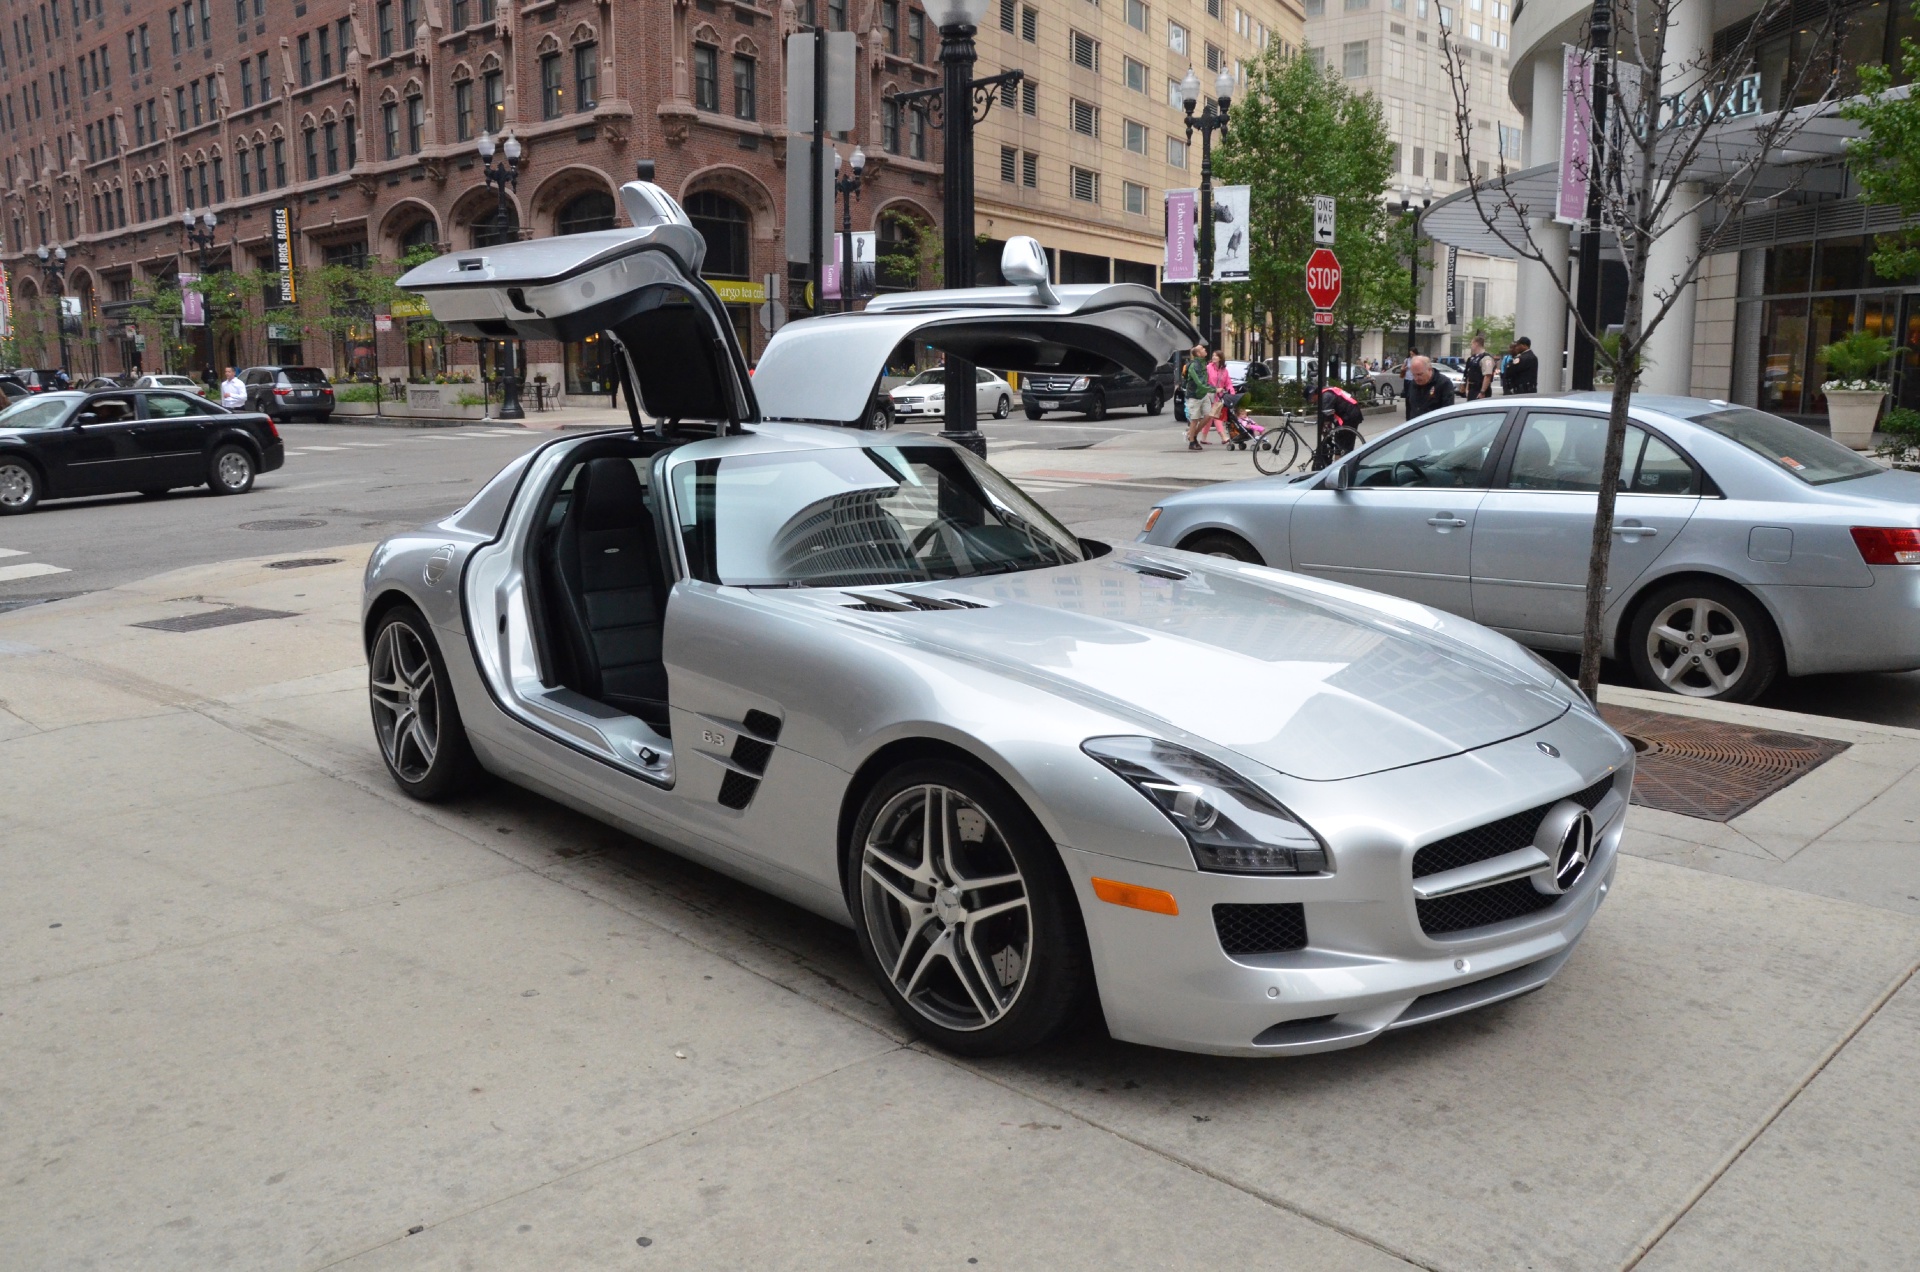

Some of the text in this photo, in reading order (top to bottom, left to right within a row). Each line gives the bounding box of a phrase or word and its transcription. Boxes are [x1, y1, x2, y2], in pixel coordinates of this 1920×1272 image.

[1317, 199, 1332, 212] ONE
[275, 209, 288, 239] BAGELS
[1177, 203, 1186, 235] Edward
[1317, 212, 1333, 225] WAY
[1174, 236, 1186, 262] Gorey
[827, 268, 835, 288] Gorey
[1308, 267, 1339, 290] STOP
[1447, 246, 1456, 312] ORDSTROM rack
[719, 288, 740, 300] argo
[742, 287, 752, 298] tea
[702, 730, 725, 746] 6.3
